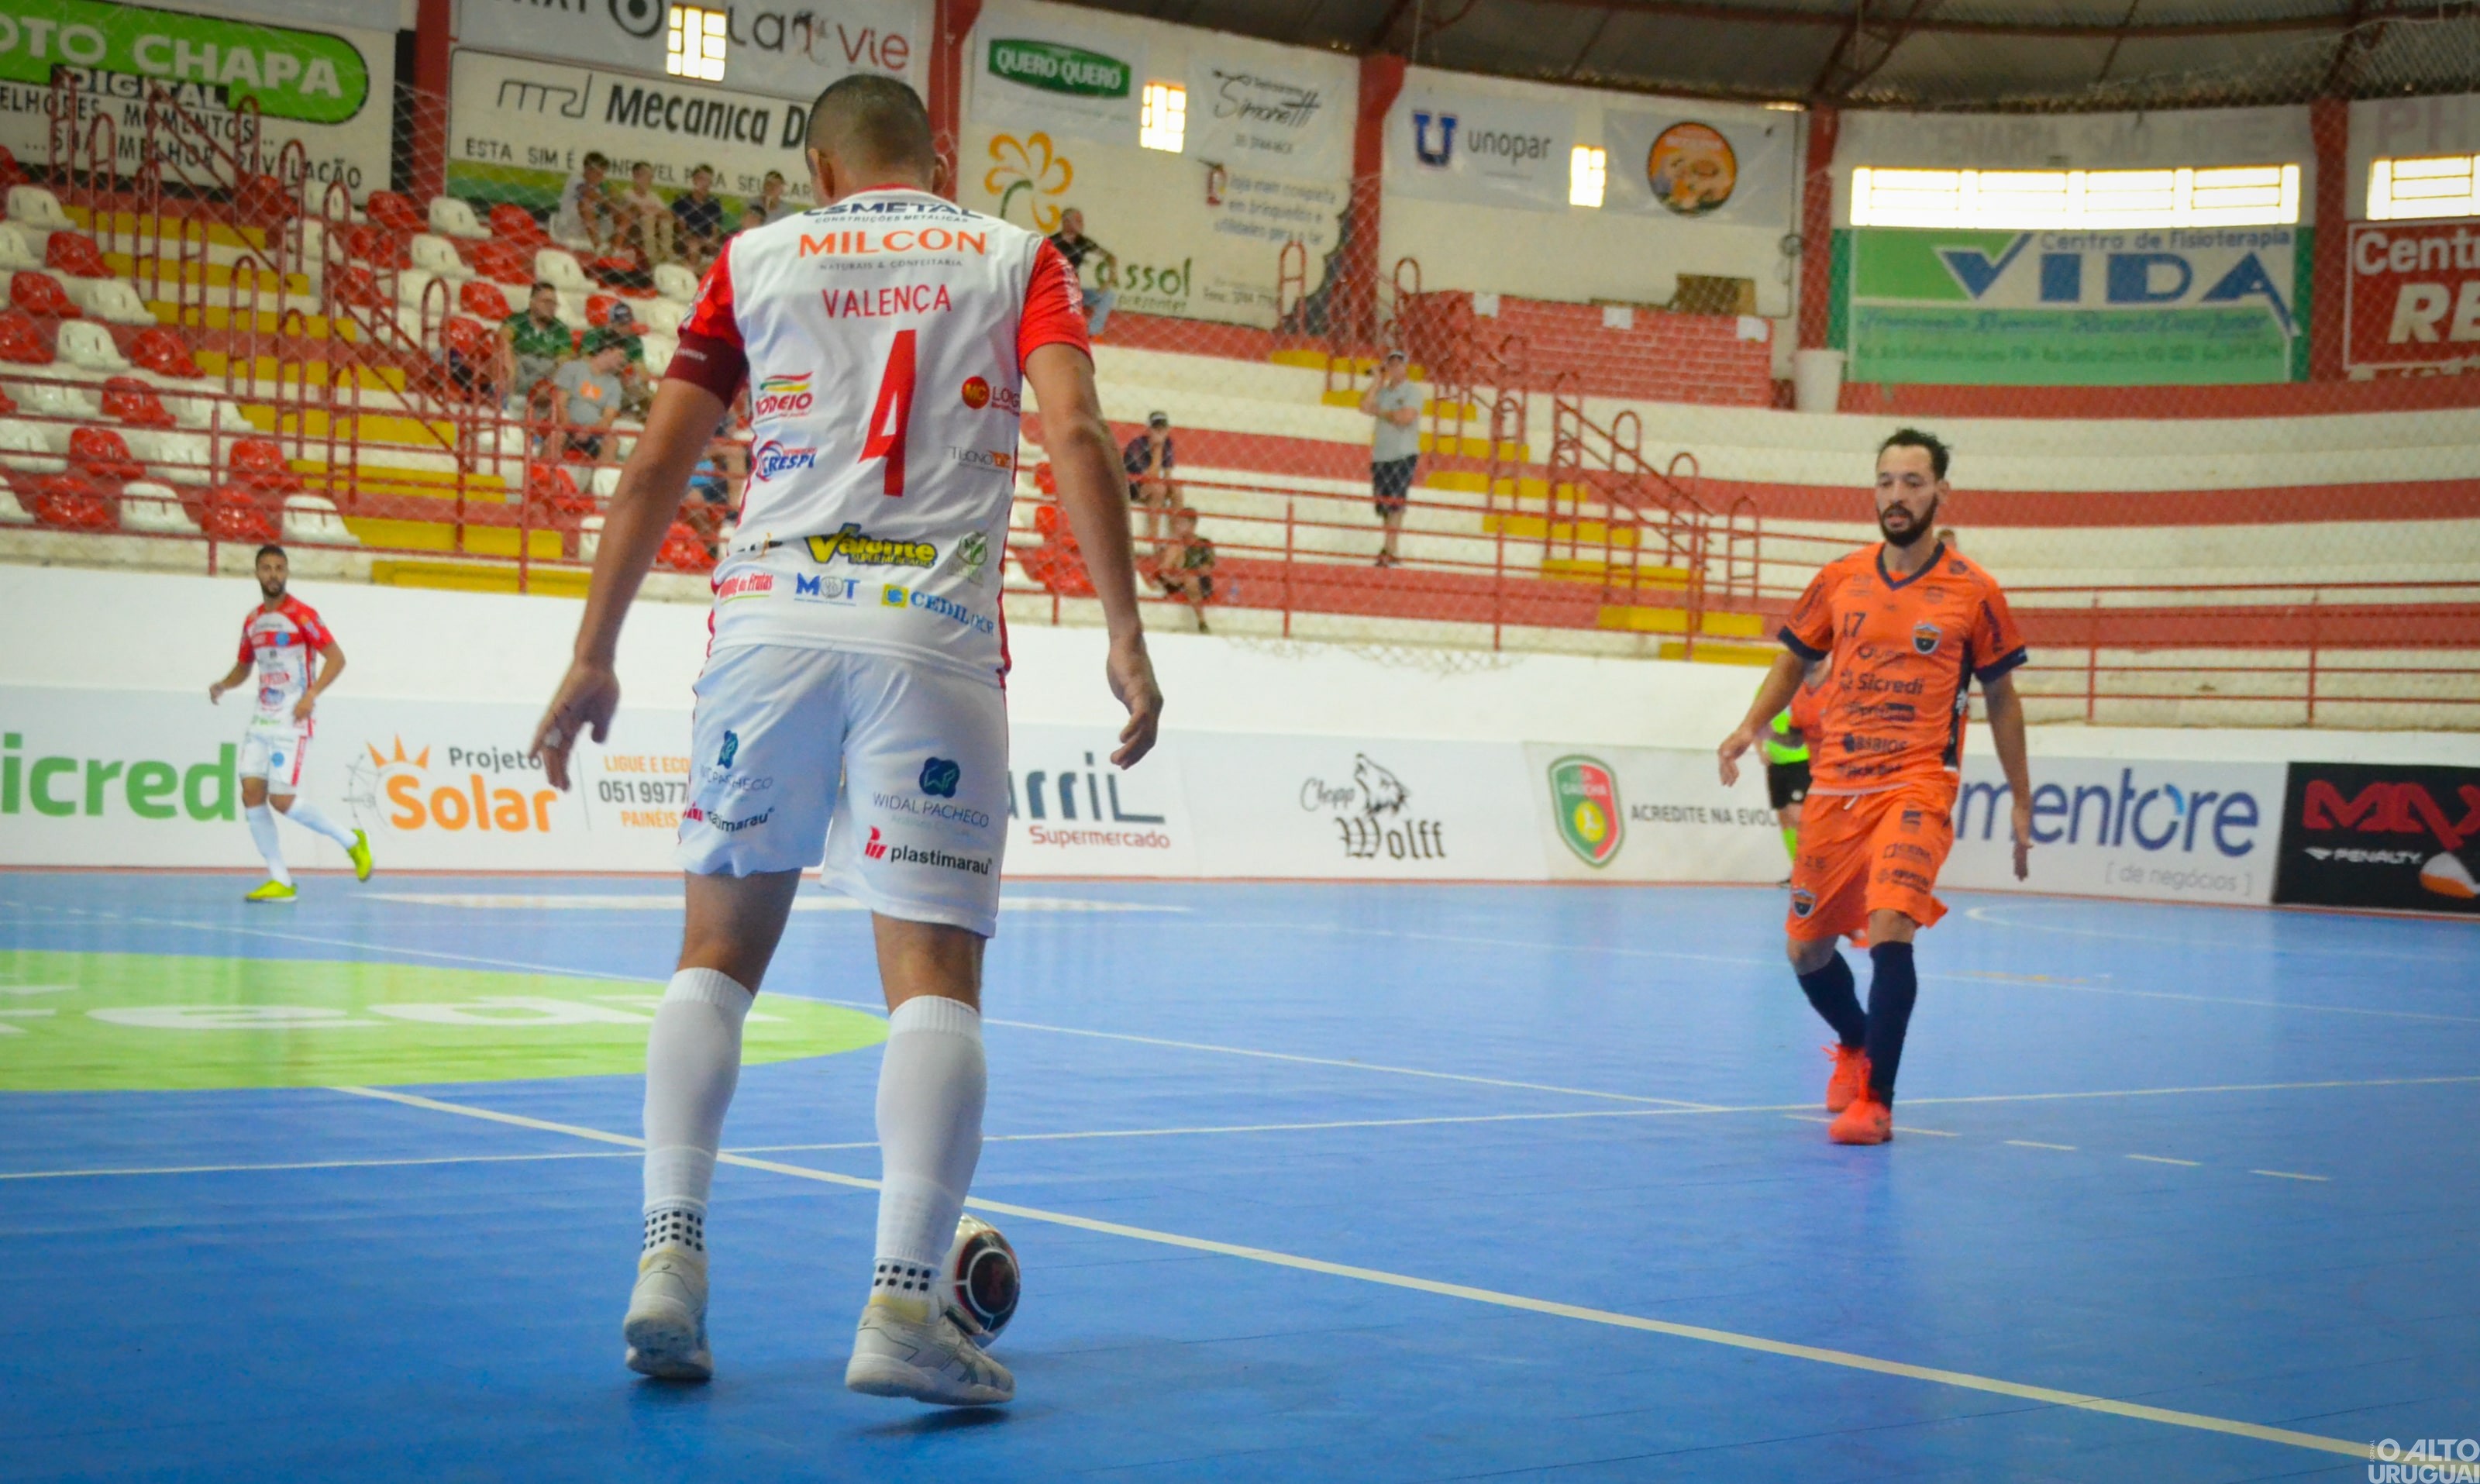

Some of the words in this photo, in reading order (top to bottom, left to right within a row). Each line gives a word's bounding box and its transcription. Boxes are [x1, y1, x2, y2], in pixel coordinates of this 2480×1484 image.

[133, 34, 343, 98] CHAPA
[997, 47, 1057, 77] QUERO
[1061, 60, 1121, 89] QUERO
[64, 66, 227, 110] DIGITAL
[467, 137, 512, 161] ESTA
[528, 146, 558, 167] SIM
[1469, 125, 1552, 164] unopar
[815, 215, 900, 223] CONSTRUÇÕES
[904, 214, 968, 223] METÁLICAS
[799, 228, 986, 257] MILCON
[2041, 232, 2124, 250] Centro
[2135, 232, 2162, 250] de
[890, 258, 963, 268] CONFEITARIA
[1940, 232, 2292, 333] VIDA
[822, 284, 952, 318] VALENÇA
[756, 392, 813, 416] ODEIO
[858, 329, 916, 497] 4
[762, 454, 816, 477] CRESPI
[1843, 611, 1866, 637] 17
[1858, 672, 1924, 694] Sicredi
[449, 746, 542, 773] Projeto
[604, 755, 646, 773] LIGUE
[650, 756, 657, 772] E
[2, 732, 249, 821] icred
[386, 774, 557, 832] Solar
[599, 780, 635, 804] 051
[1300, 778, 1355, 811] Chopp
[621, 807, 679, 828] PAINÉIS
[873, 791, 920, 814] WIDAL
[923, 801, 990, 828] PACHECO
[1631, 804, 1707, 824] ACREDITE
[1710, 807, 1734, 824] NA
[1029, 825, 1171, 849] Supermercado
[1334, 815, 1446, 860] Wolff
[2120, 865, 2144, 884] de
[2149, 866, 2237, 893] negócios
